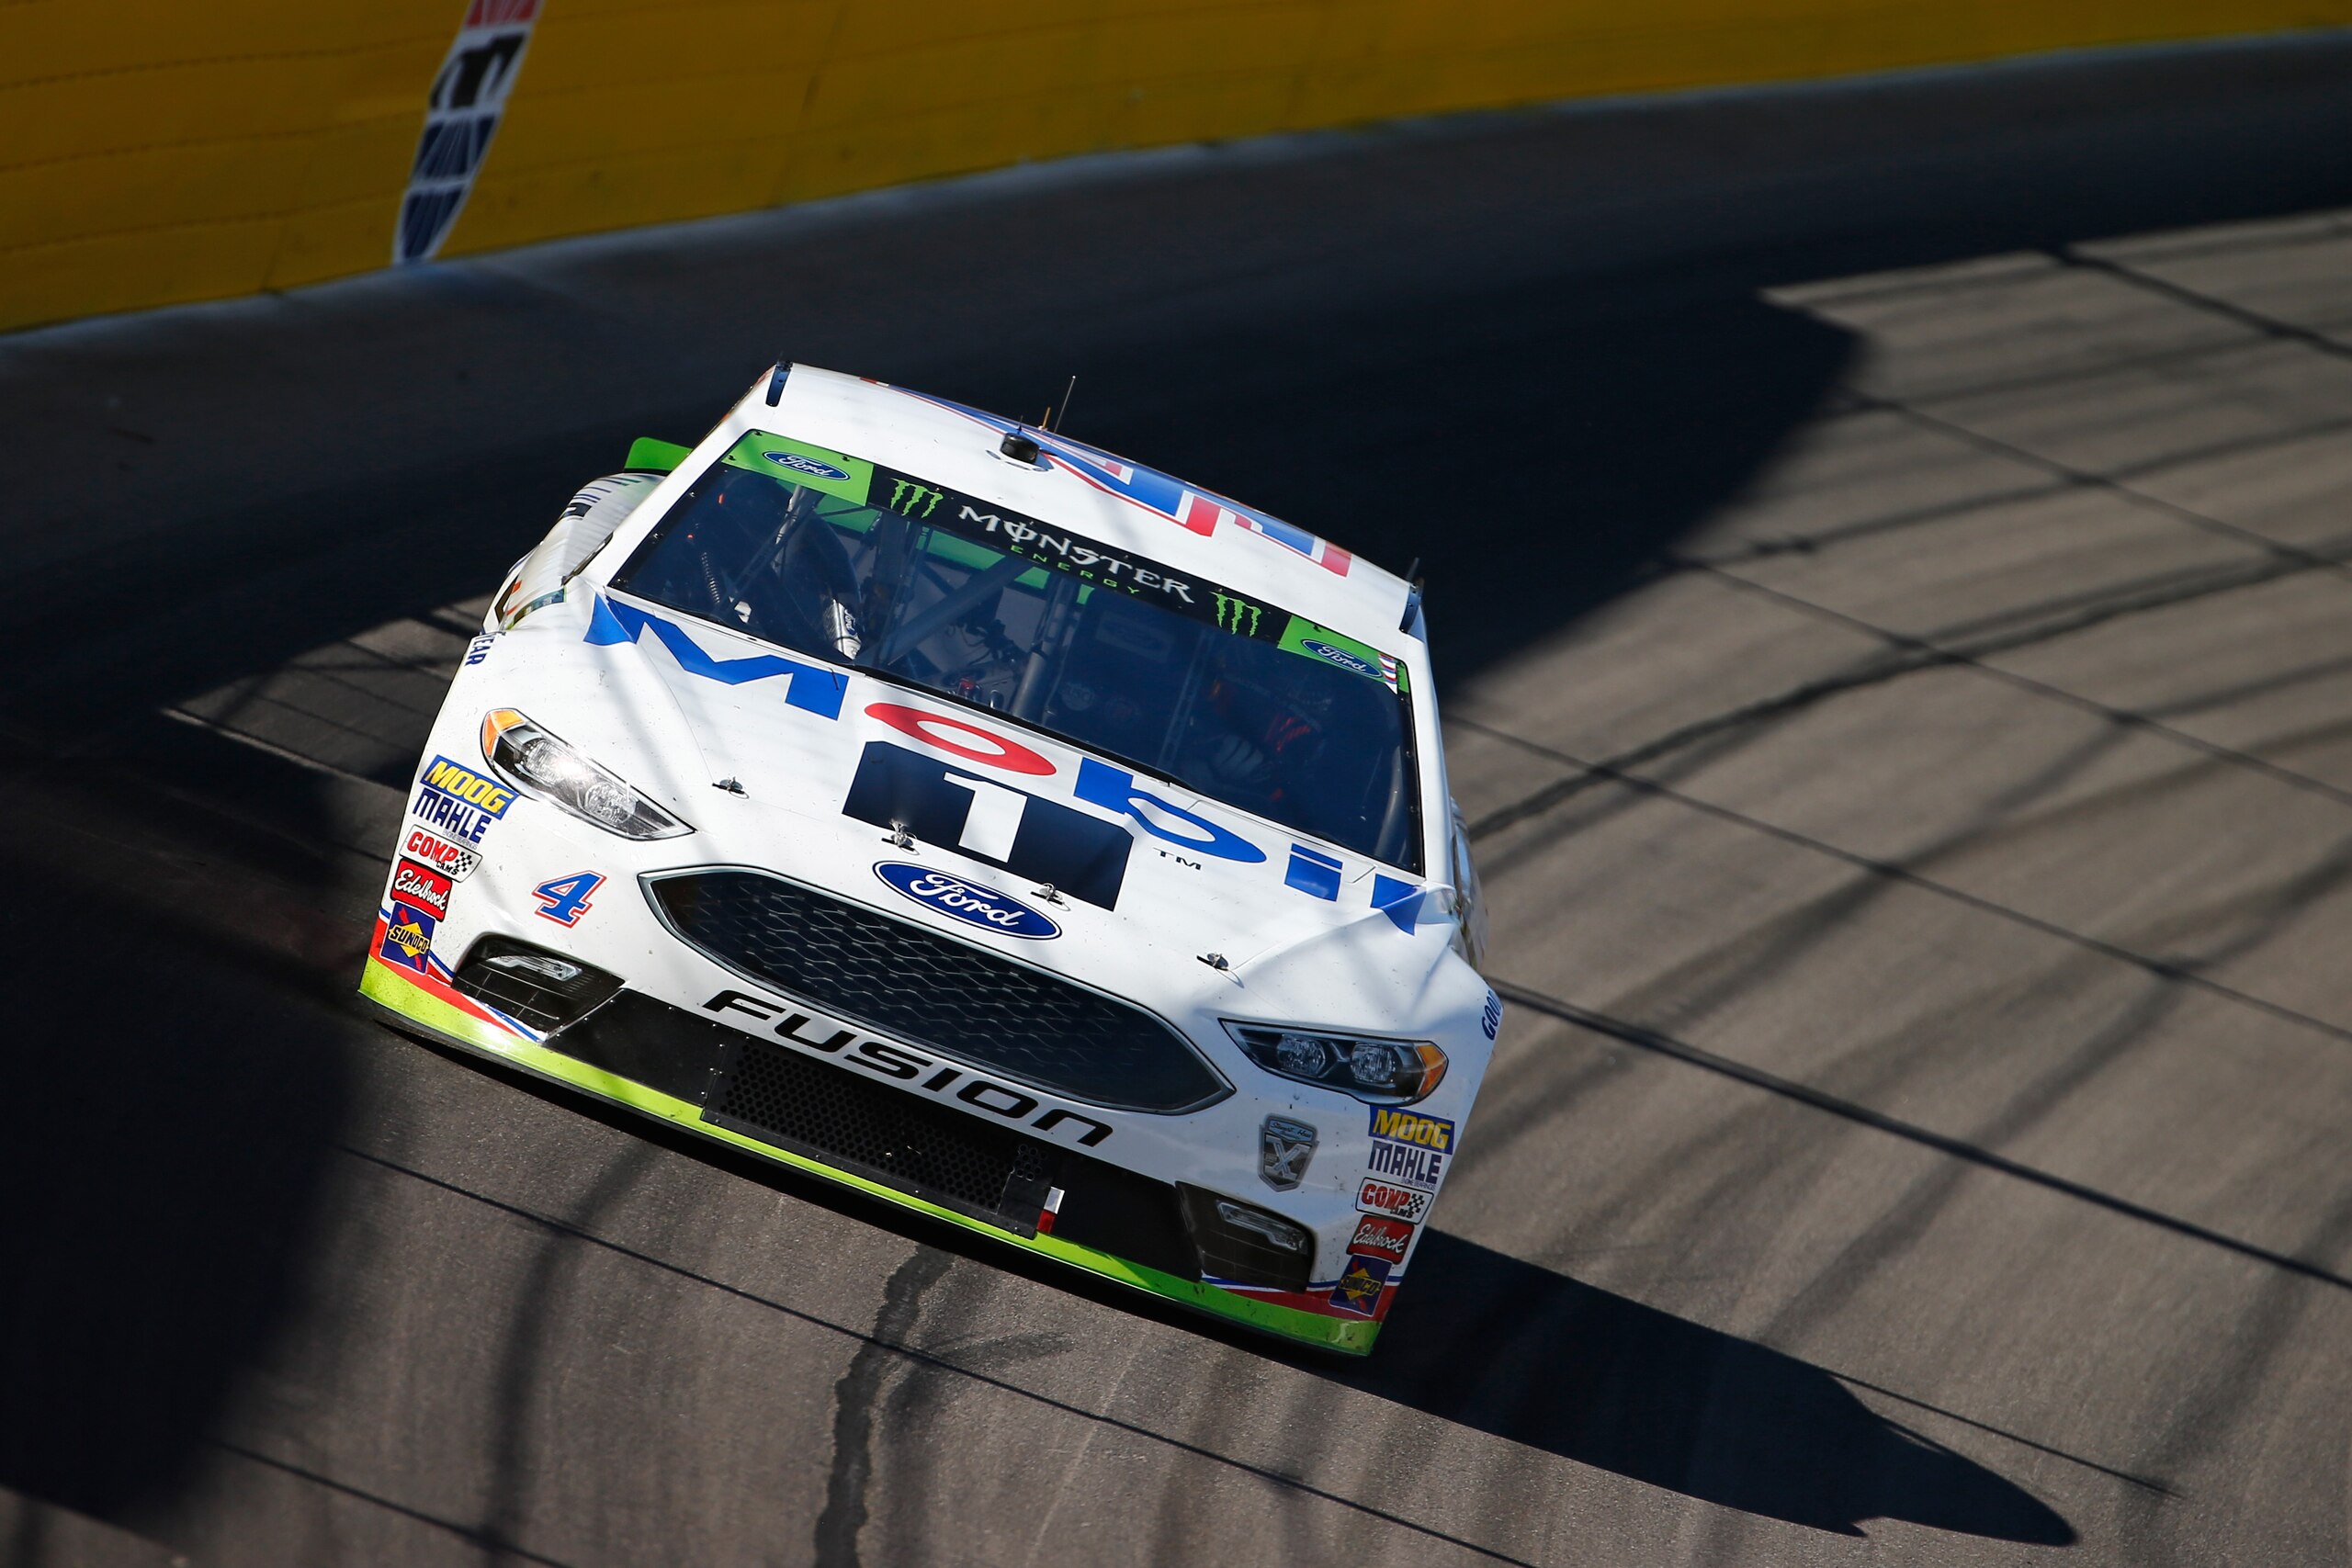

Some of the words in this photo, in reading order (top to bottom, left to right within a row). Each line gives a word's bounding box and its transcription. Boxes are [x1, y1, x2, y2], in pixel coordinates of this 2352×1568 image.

[779, 455, 833, 477] Ford
[957, 504, 1194, 604] MONSTER
[1011, 545, 1141, 594] ENERGY
[1317, 646, 1367, 671] Ford
[424, 761, 514, 814] MOOG
[413, 788, 492, 844] MAHLE
[943, 771, 1028, 863] 1
[408, 831, 458, 863] COMP
[435, 860, 459, 875] CAMS
[1151, 848, 1202, 870] TM
[394, 869, 447, 910] Edelbrock
[532, 870, 606, 929] 4
[910, 871, 1026, 928] Ford
[390, 926, 429, 953] SUNOCO
[1373, 1109, 1451, 1150] MOOG
[1368, 1140, 1442, 1184] MAHLE
[1362, 1183, 1411, 1210] COMP
[1353, 1224, 1409, 1253] Edelbrock
